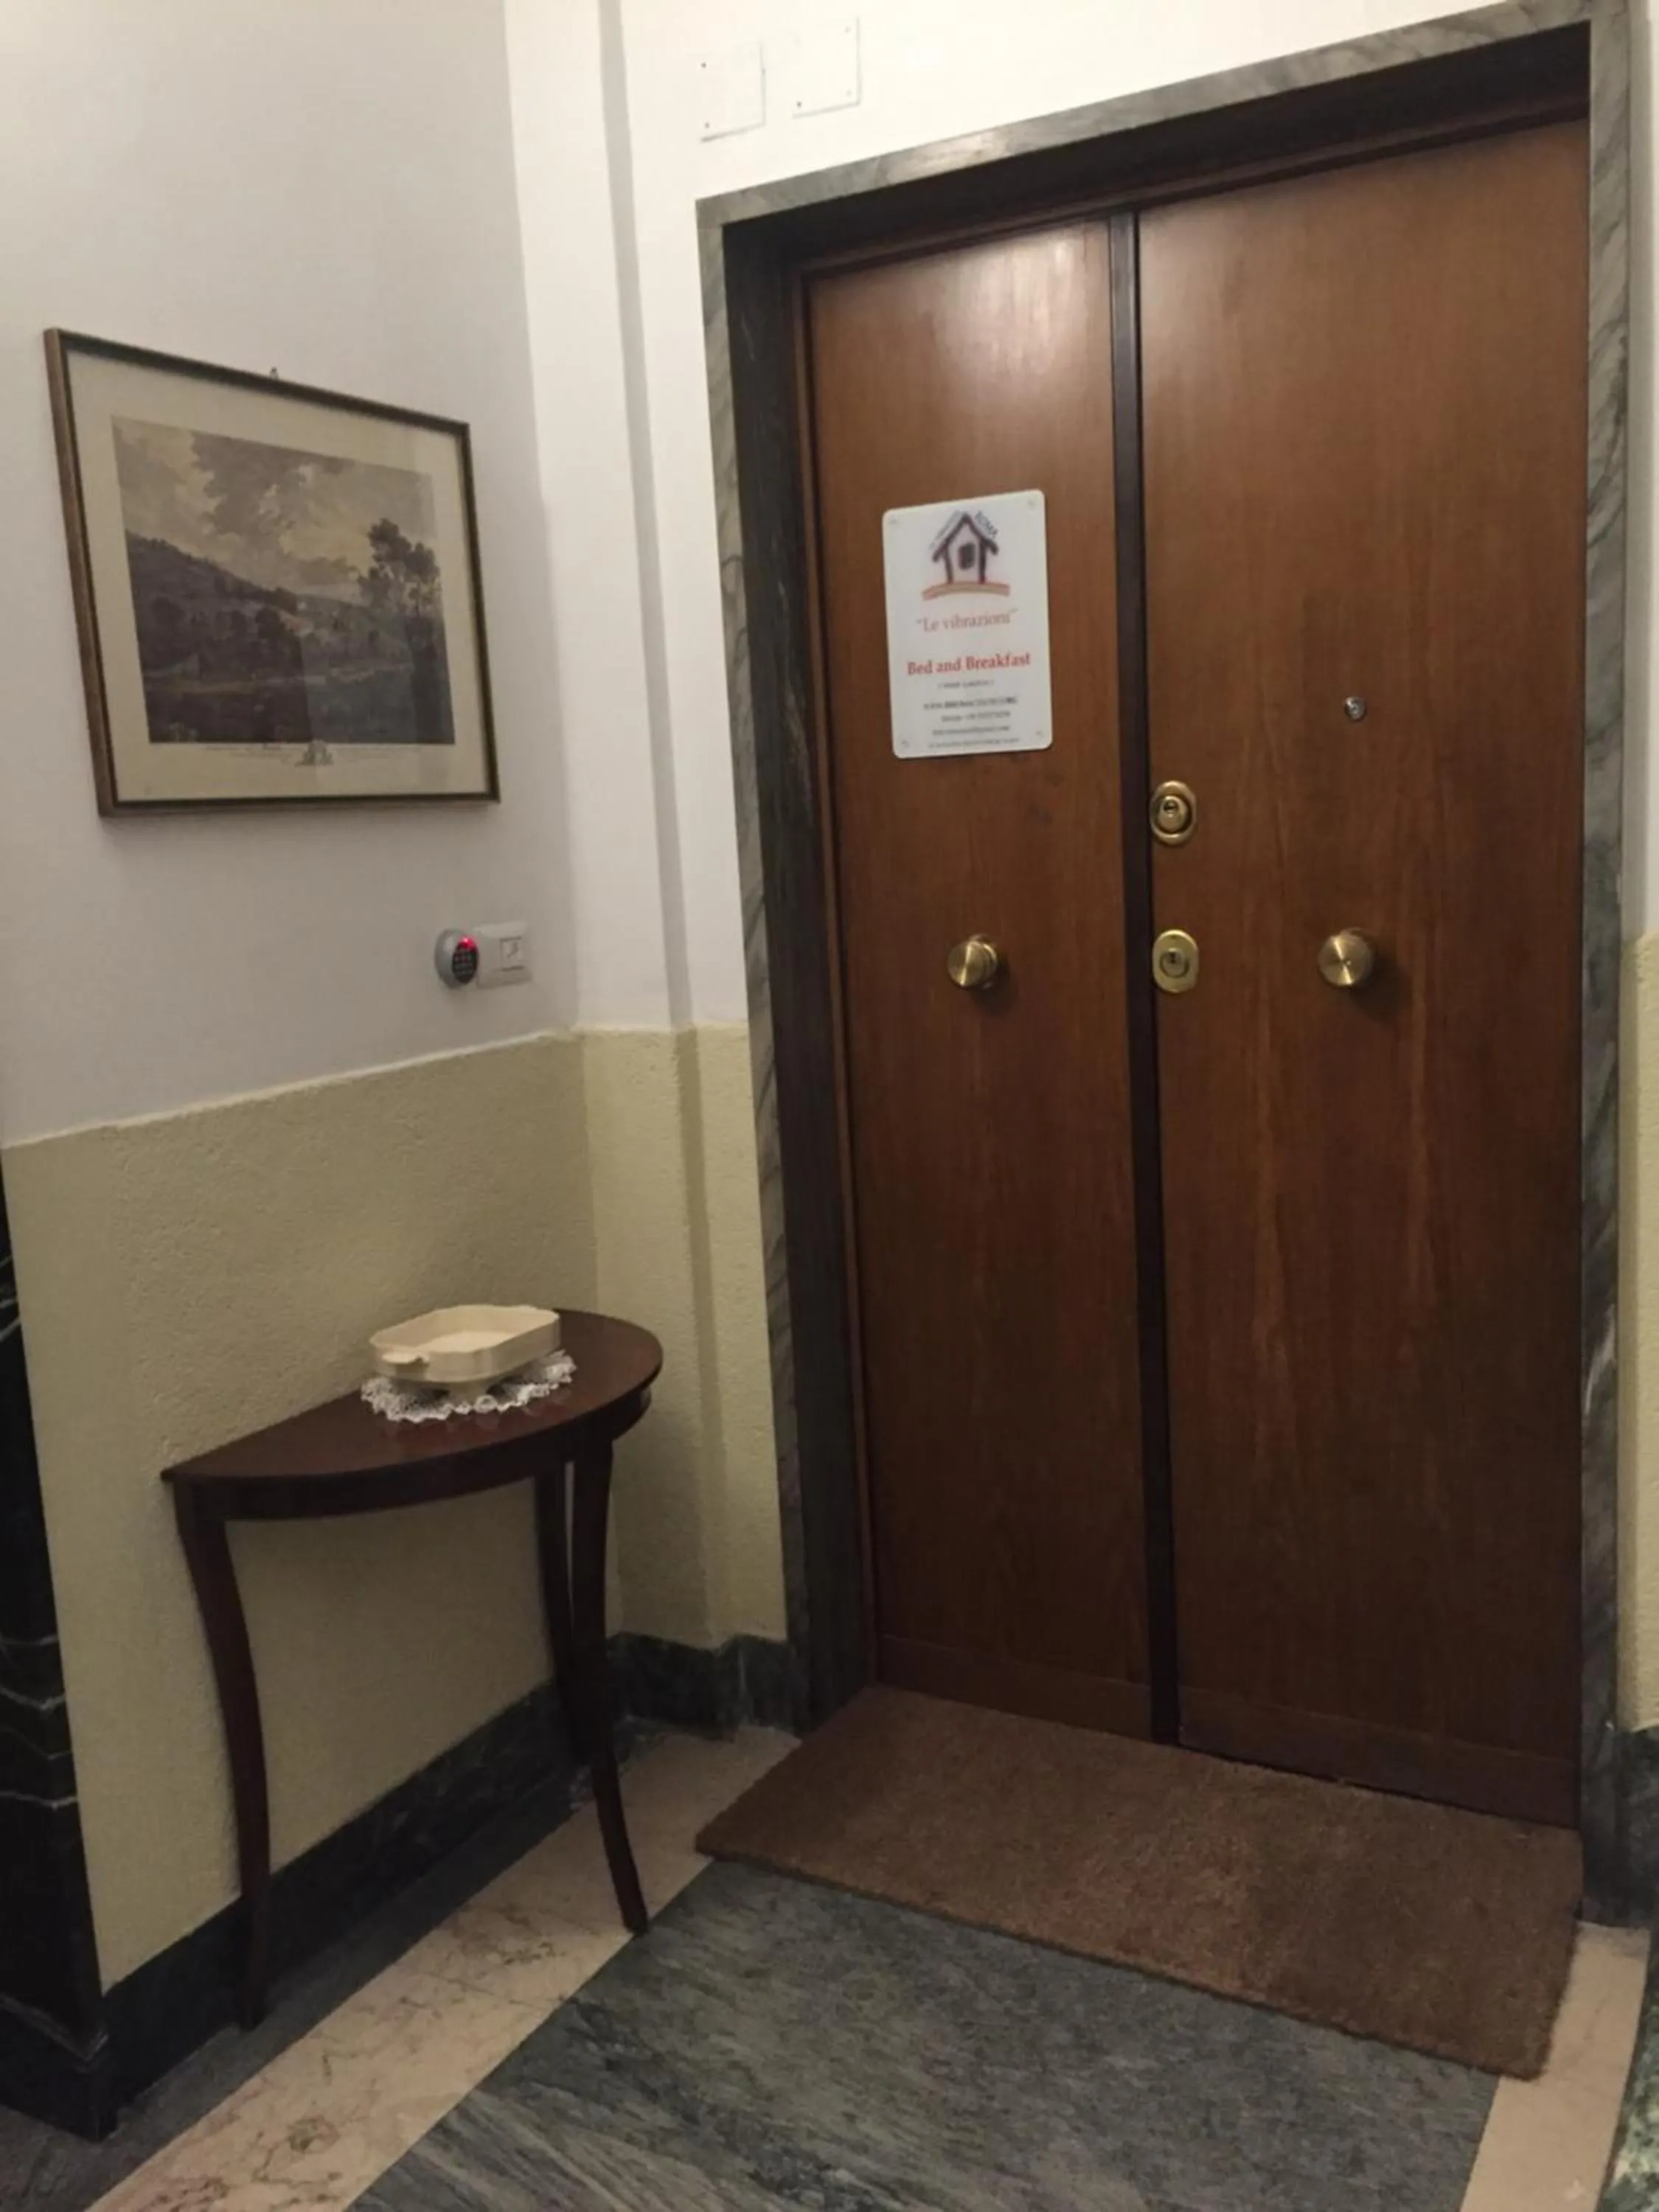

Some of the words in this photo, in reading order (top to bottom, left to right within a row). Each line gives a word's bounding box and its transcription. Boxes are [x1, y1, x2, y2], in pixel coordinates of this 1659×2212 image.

[907, 659, 933, 675] Bed
[936, 658, 961, 672] and
[965, 653, 1031, 671] Breakfast
